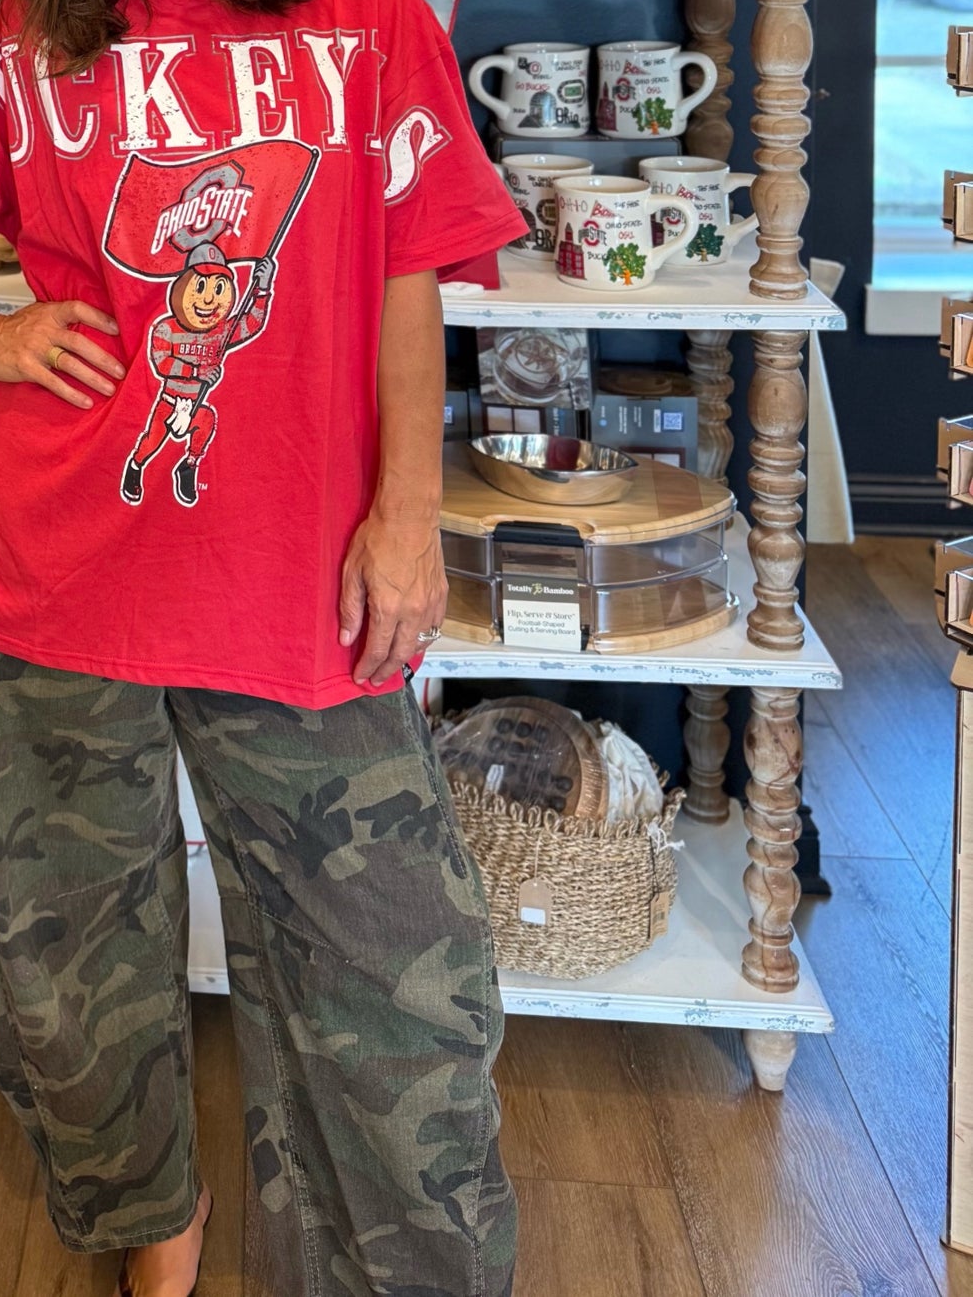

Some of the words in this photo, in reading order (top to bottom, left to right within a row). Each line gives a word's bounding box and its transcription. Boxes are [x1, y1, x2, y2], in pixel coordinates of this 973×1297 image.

[151, 196, 201, 255] OHIO
[195, 187, 254, 238] STATE
[507, 584, 533, 593] Totally
[544, 586, 574, 595] Bamboo
[535, 627, 557, 635] Serving
